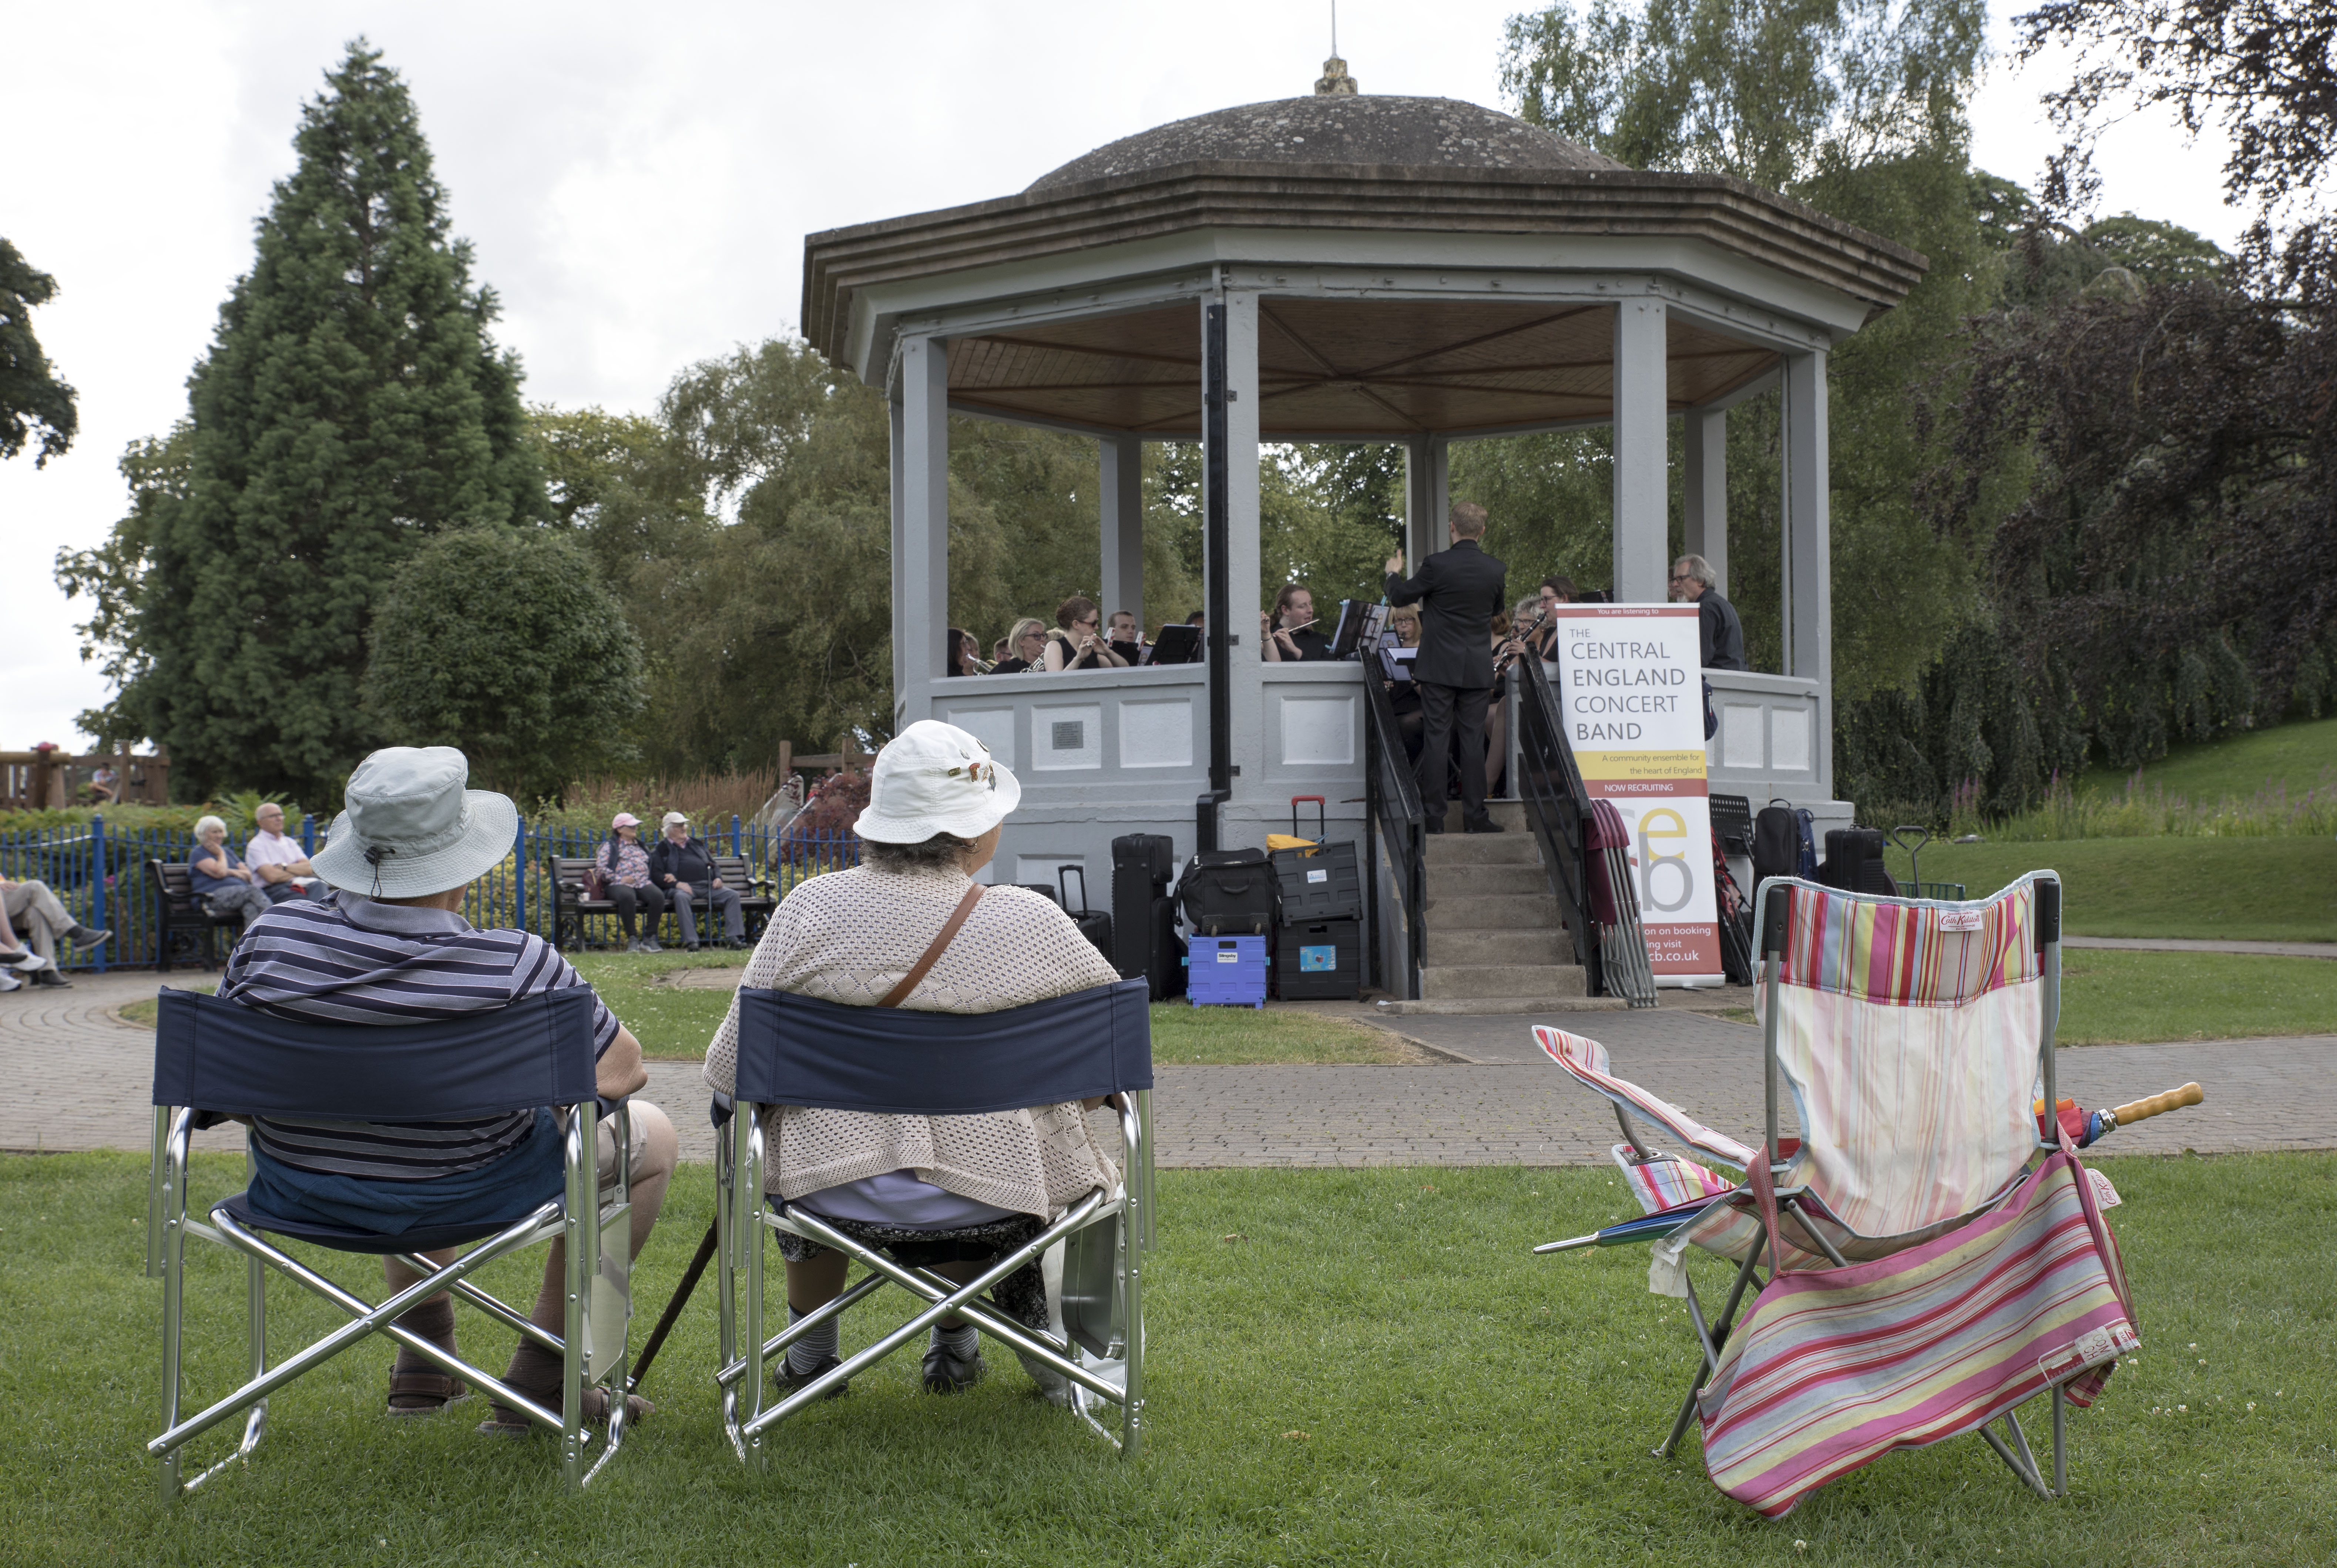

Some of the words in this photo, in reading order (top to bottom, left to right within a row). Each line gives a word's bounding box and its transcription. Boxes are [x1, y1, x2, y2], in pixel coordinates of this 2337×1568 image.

[1569, 629, 1590, 638] THE
[1571, 642, 1671, 659] CENTRAL
[1573, 668, 1685, 686] ENGLAND
[1574, 695, 1678, 714] CONCERT
[1577, 722, 1642, 741] BAND
[1609, 754, 1651, 763] community
[1673, 766, 1702, 776] England
[1628, 783, 1674, 792] RECRUITING
[1941, 915, 1957, 925] Cath
[1957, 915, 1980, 925] Kidston
[1673, 926, 1711, 936] booking
[1646, 940, 1661, 950] ing
[1663, 940, 1682, 948] visit
[1649, 950, 1699, 961] cb.co.uk
[2103, 1190, 2116, 1205] Cath
[2119, 1332, 2133, 1351] EUROH
[2049, 1352, 2070, 1366] features
